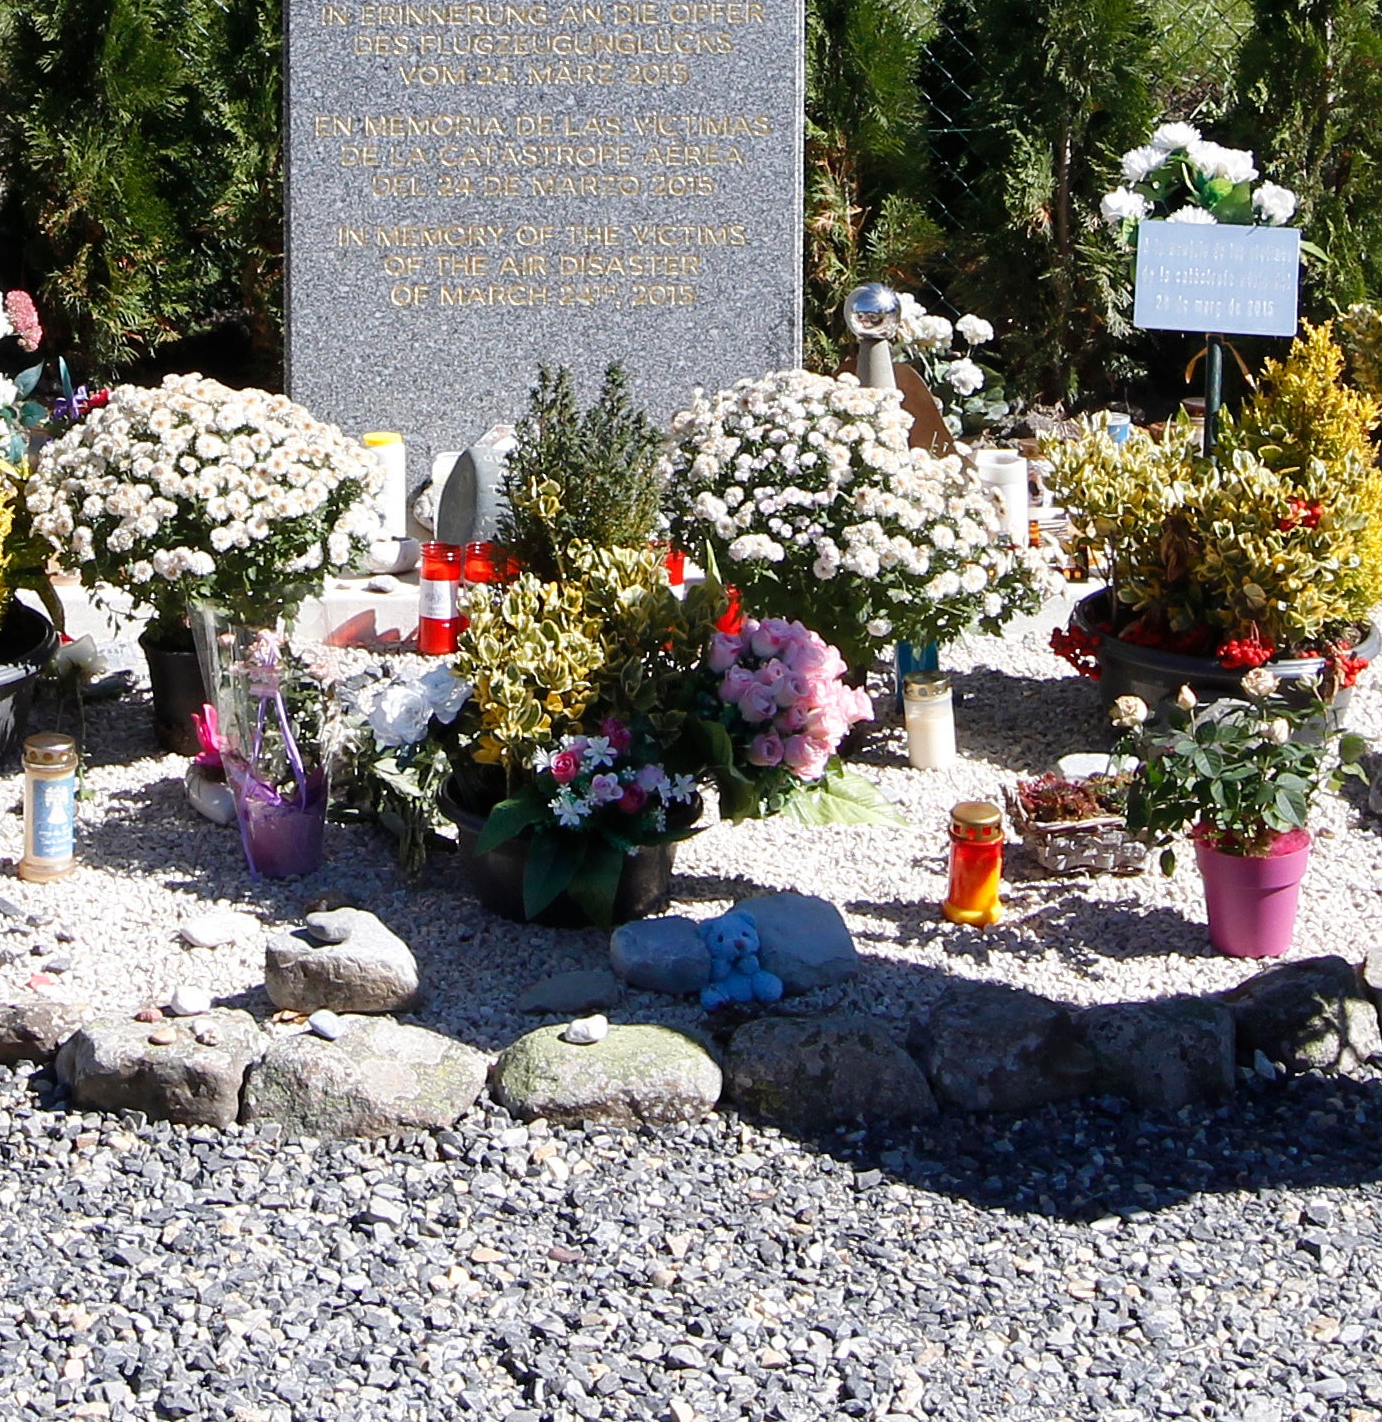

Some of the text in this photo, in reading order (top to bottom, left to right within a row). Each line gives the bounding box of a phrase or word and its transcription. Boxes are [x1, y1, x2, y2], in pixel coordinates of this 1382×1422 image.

[320, 2, 766, 26] IN ERINNERUNG AN DIE OPFER
[354, 29, 735, 55] DES FLUGZEUGUNGLÜCKS
[398, 60, 691, 85] VOM 24. MÄRZ 2015
[314, 115, 354, 137] EN
[364, 115, 506, 137] MEMORIA
[516, 115, 555, 137] DE
[564, 115, 624, 137] LAS
[340, 140, 747, 167] DE LA CATÁSTROFE AÉREA
[372, 175, 716, 197] DEL 24 DE MARZO 2015
[337, 225, 748, 247] IN MEMORY OF THE VICTIMS
[383, 254, 702, 277] OF THE AIR DISASTER
[390, 285, 431, 307] OF
[439, 285, 549, 307] MARCH
[631, 284, 698, 306] 2015
